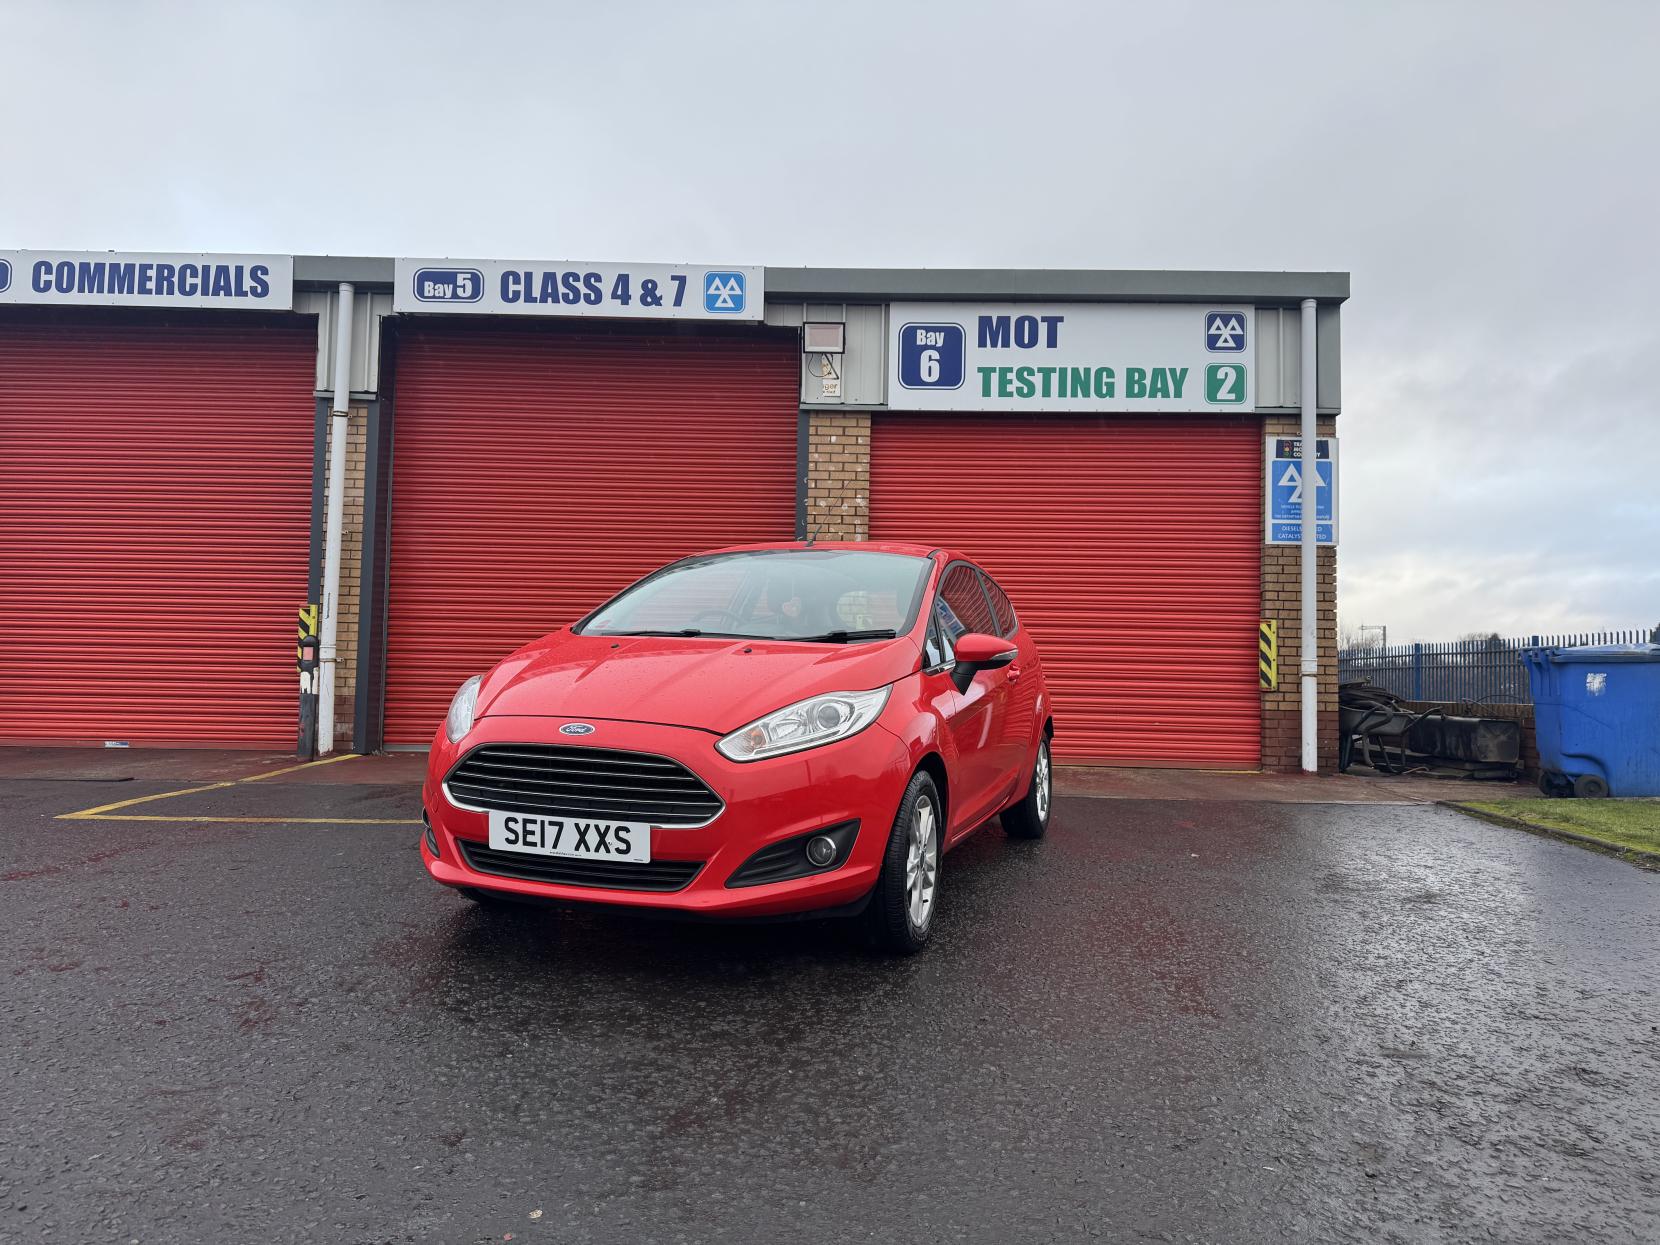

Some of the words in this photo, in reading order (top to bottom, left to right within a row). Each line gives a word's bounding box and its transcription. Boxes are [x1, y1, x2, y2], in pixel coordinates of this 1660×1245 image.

[31, 260, 270, 298] COMMERCIALS
[424, 281, 453, 299] Bay
[456, 273, 472, 298] 5
[500, 270, 603, 305] CLASS
[611, 273, 632, 306] 4
[639, 278, 663, 307] &
[670, 274, 687, 307] 7
[916, 329, 945, 347] Bay
[978, 315, 1064, 349] MOT
[920, 349, 941, 383] 6
[977, 366, 1115, 399] TESTING
[1125, 367, 1189, 399] BAY
[1216, 366, 1237, 400] 2
[504, 816, 564, 850] SE17
[574, 822, 632, 855] XXS
